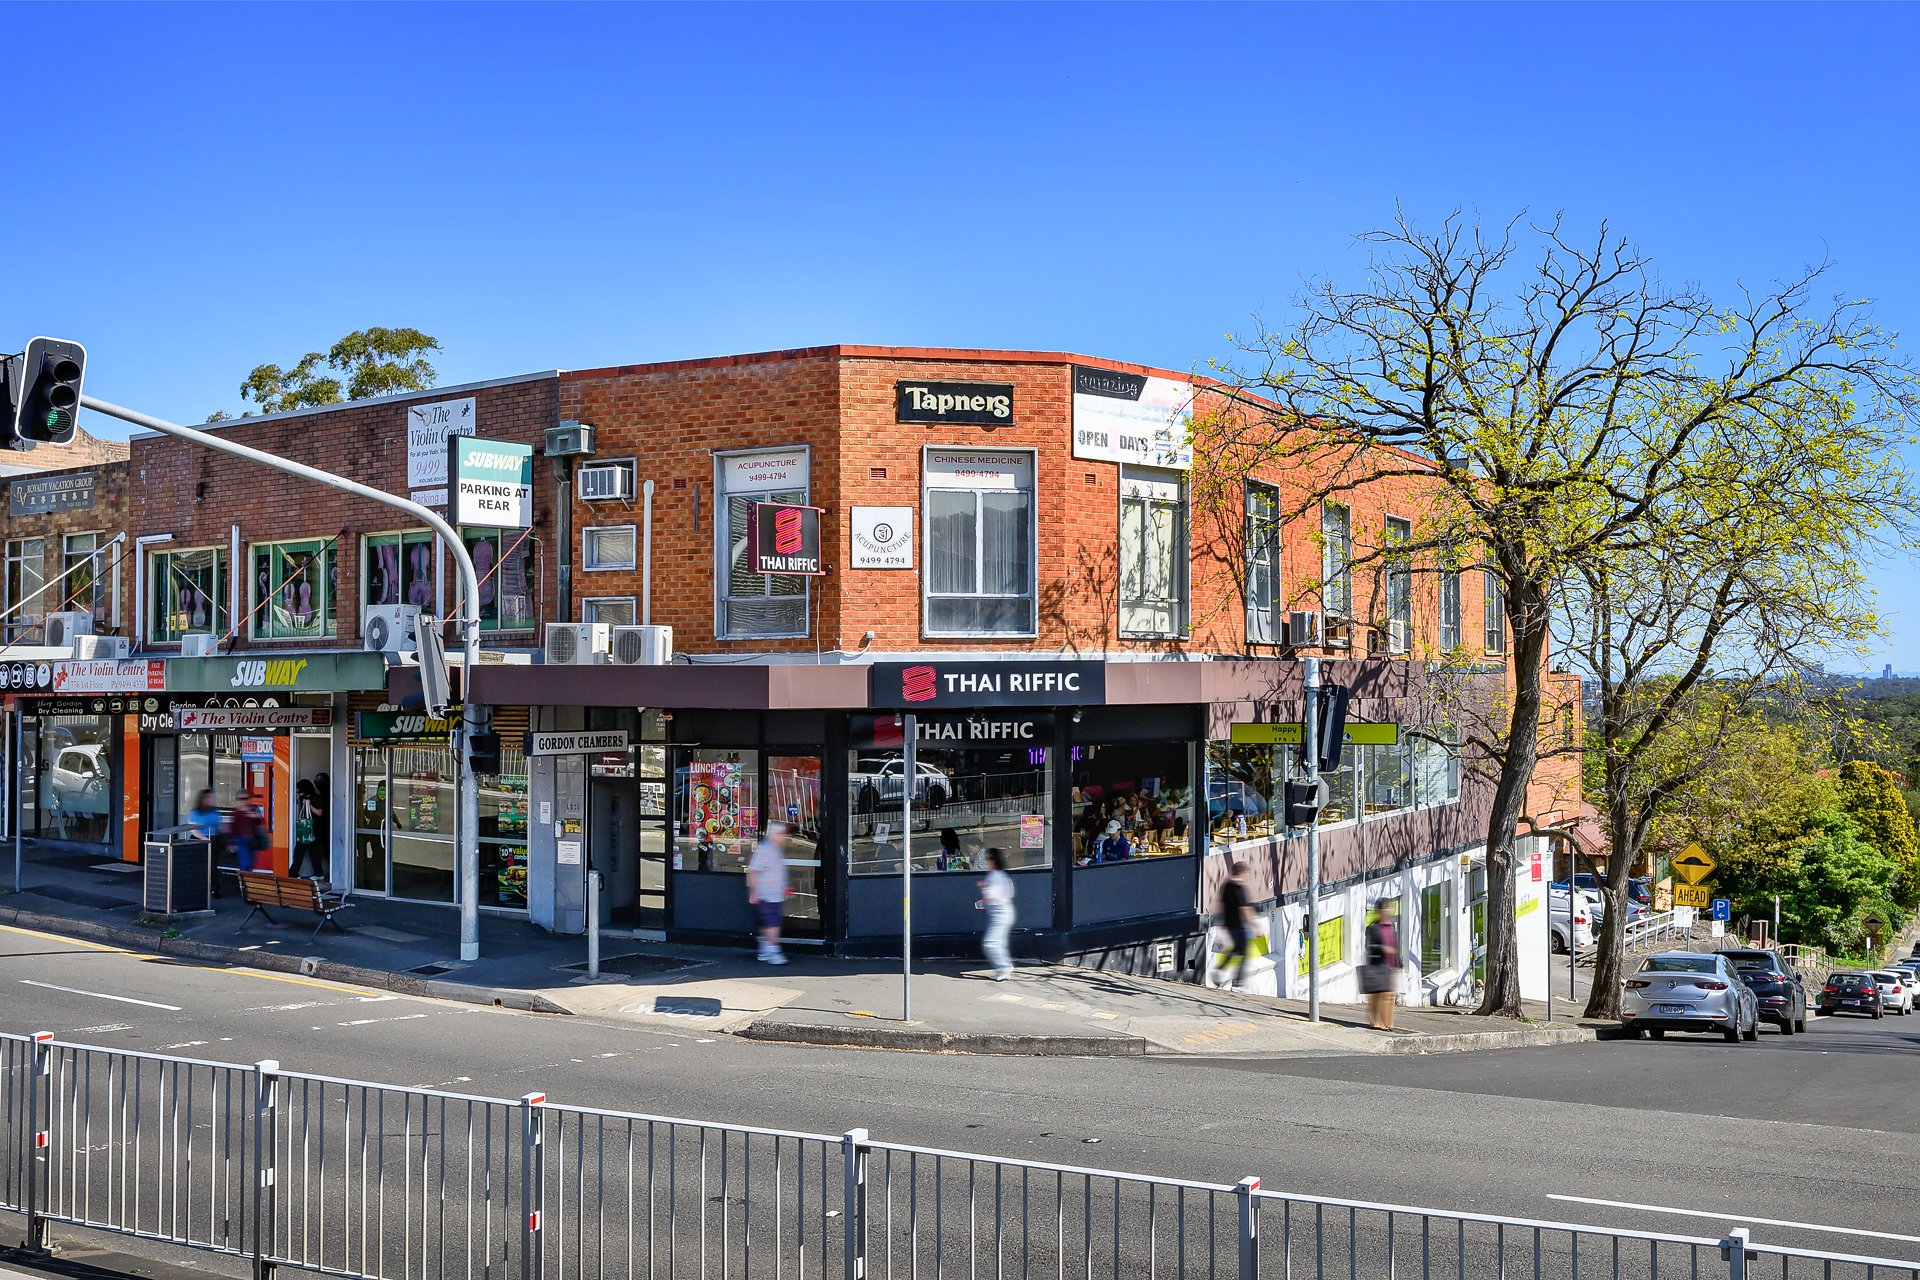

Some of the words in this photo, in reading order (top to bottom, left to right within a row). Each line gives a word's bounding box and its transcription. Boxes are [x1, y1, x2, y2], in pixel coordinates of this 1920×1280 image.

[905, 386, 1010, 418] Tapners
[432, 406, 450, 424] The
[411, 427, 438, 447] Violin
[1078, 429, 1108, 448] OPEN
[1119, 434, 1148, 452] DAYS
[414, 458, 440, 477] 9499
[463, 451, 528, 471] SUBWAY
[737, 459, 797, 470] ACUPUNCTURE
[934, 455, 976, 464] CHINESE
[977, 457, 1023, 465] MEDICINE
[954, 469, 1000, 478] 9499-4794
[27, 482, 48, 493] ROYALTY
[49, 479, 74, 491] VACATION
[74, 477, 93, 488] GROUP
[460, 483, 511, 497] PARKING
[515, 488, 529, 498] AT
[412, 493, 439, 504] Parking
[478, 499, 510, 511] REAR
[854, 531, 912, 554] ACUPUNCTURE
[760, 555, 786, 570] THAI
[788, 557, 818, 572] RIFFIC
[860, 556, 882, 564] 9499
[70, 662, 87, 676] The
[88, 662, 114, 676] Violin
[116, 661, 146, 676] Centre
[230, 658, 308, 687] SUBWAY
[90, 680, 104, 689] Floor
[943, 673, 1001, 693] THAI
[1009, 673, 1080, 692] RIFFIC
[51, 707, 84, 715] Cleaning
[200, 712, 225, 724] The
[230, 711, 265, 724] Violin
[268, 711, 308, 724] Centre
[142, 714, 158, 731] Dry
[390, 715, 463, 733] SUBWAY
[1271, 725, 1297, 734] Happy
[915, 722, 963, 740] THAI
[969, 721, 1034, 739] RIFFIC
[538, 736, 575, 751] GORDON
[577, 735, 623, 749] CHAMBERS
[690, 762, 717, 774] LUNCH
[1677, 888, 1706, 903] AHEAD
[1716, 900, 1726, 911] P
